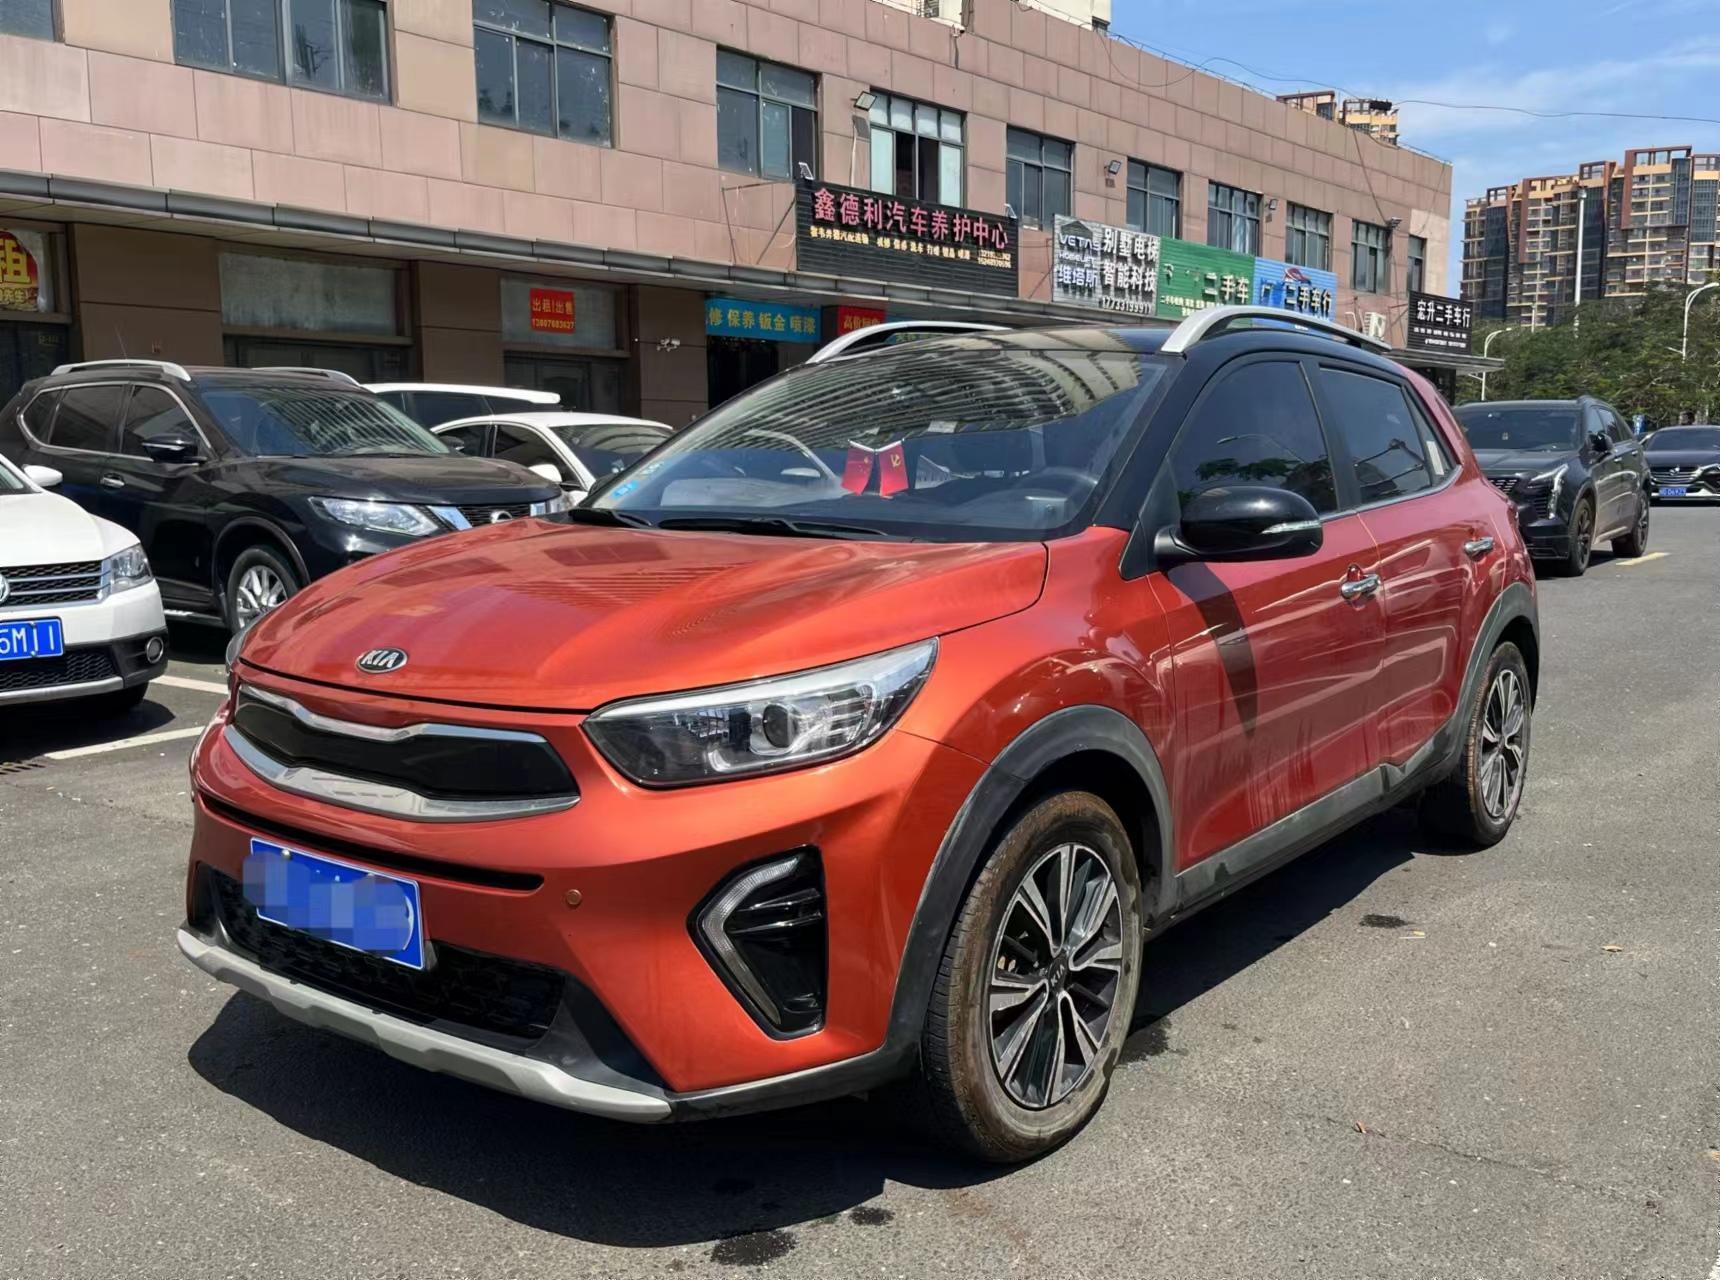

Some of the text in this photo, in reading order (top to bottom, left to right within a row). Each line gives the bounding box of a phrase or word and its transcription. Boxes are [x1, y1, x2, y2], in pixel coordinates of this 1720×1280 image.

[813, 187, 1009, 249] 鑫德利汽车养护中心
[1059, 233, 1101, 251] VETAS
[1104, 228, 1160, 262] 别墅电梯
[1057, 264, 1098, 288] 维塔斯
[1103, 259, 1157, 292] 智能科技
[1204, 272, 1250, 304] 二手车
[1286, 284, 1332, 313] 二手车行
[727, 308, 755, 329] 保养
[759, 311, 785, 332] 钣金
[789, 315, 816, 336] 喷漆
[1417, 299, 1471, 328] 宏升二手车行
[361, 650, 400, 668] KIA
[1050, 964, 1066, 987] KIA
